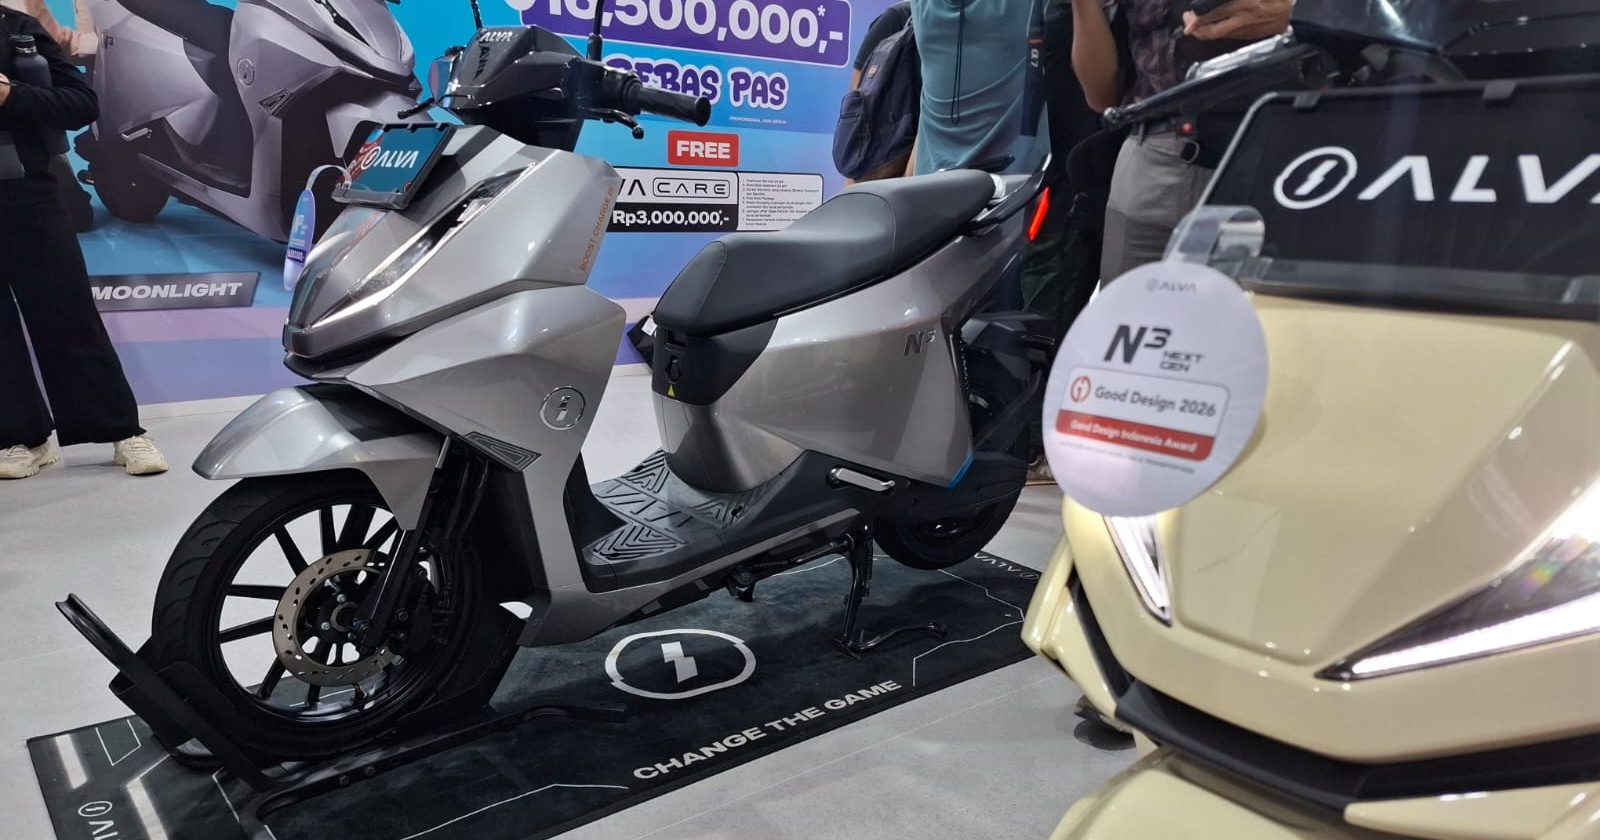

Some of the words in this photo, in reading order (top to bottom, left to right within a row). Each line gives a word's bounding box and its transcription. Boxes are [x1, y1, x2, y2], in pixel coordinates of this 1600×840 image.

[730, 71, 787, 107] PAS
[373, 150, 419, 169] ALVA
[676, 140, 731, 159] FREE
[656, 182, 726, 195] CARE
[1356, 154, 1600, 204] ALV
[579, 238, 597, 272] BOOST
[91, 281, 243, 300] MOONLIGHT
[1159, 361, 1191, 373] GEN
[1163, 351, 1205, 364] NEXT
[1094, 386, 1128, 405] Good
[1130, 391, 1176, 413] Design
[1180, 399, 1217, 418] 2026
[1120, 427, 1163, 446] Indonesia
[1163, 437, 1198, 453] Award
[633, 726, 768, 780] CHANGE
[764, 706, 827, 731] THE
[823, 680, 902, 710] GAME
